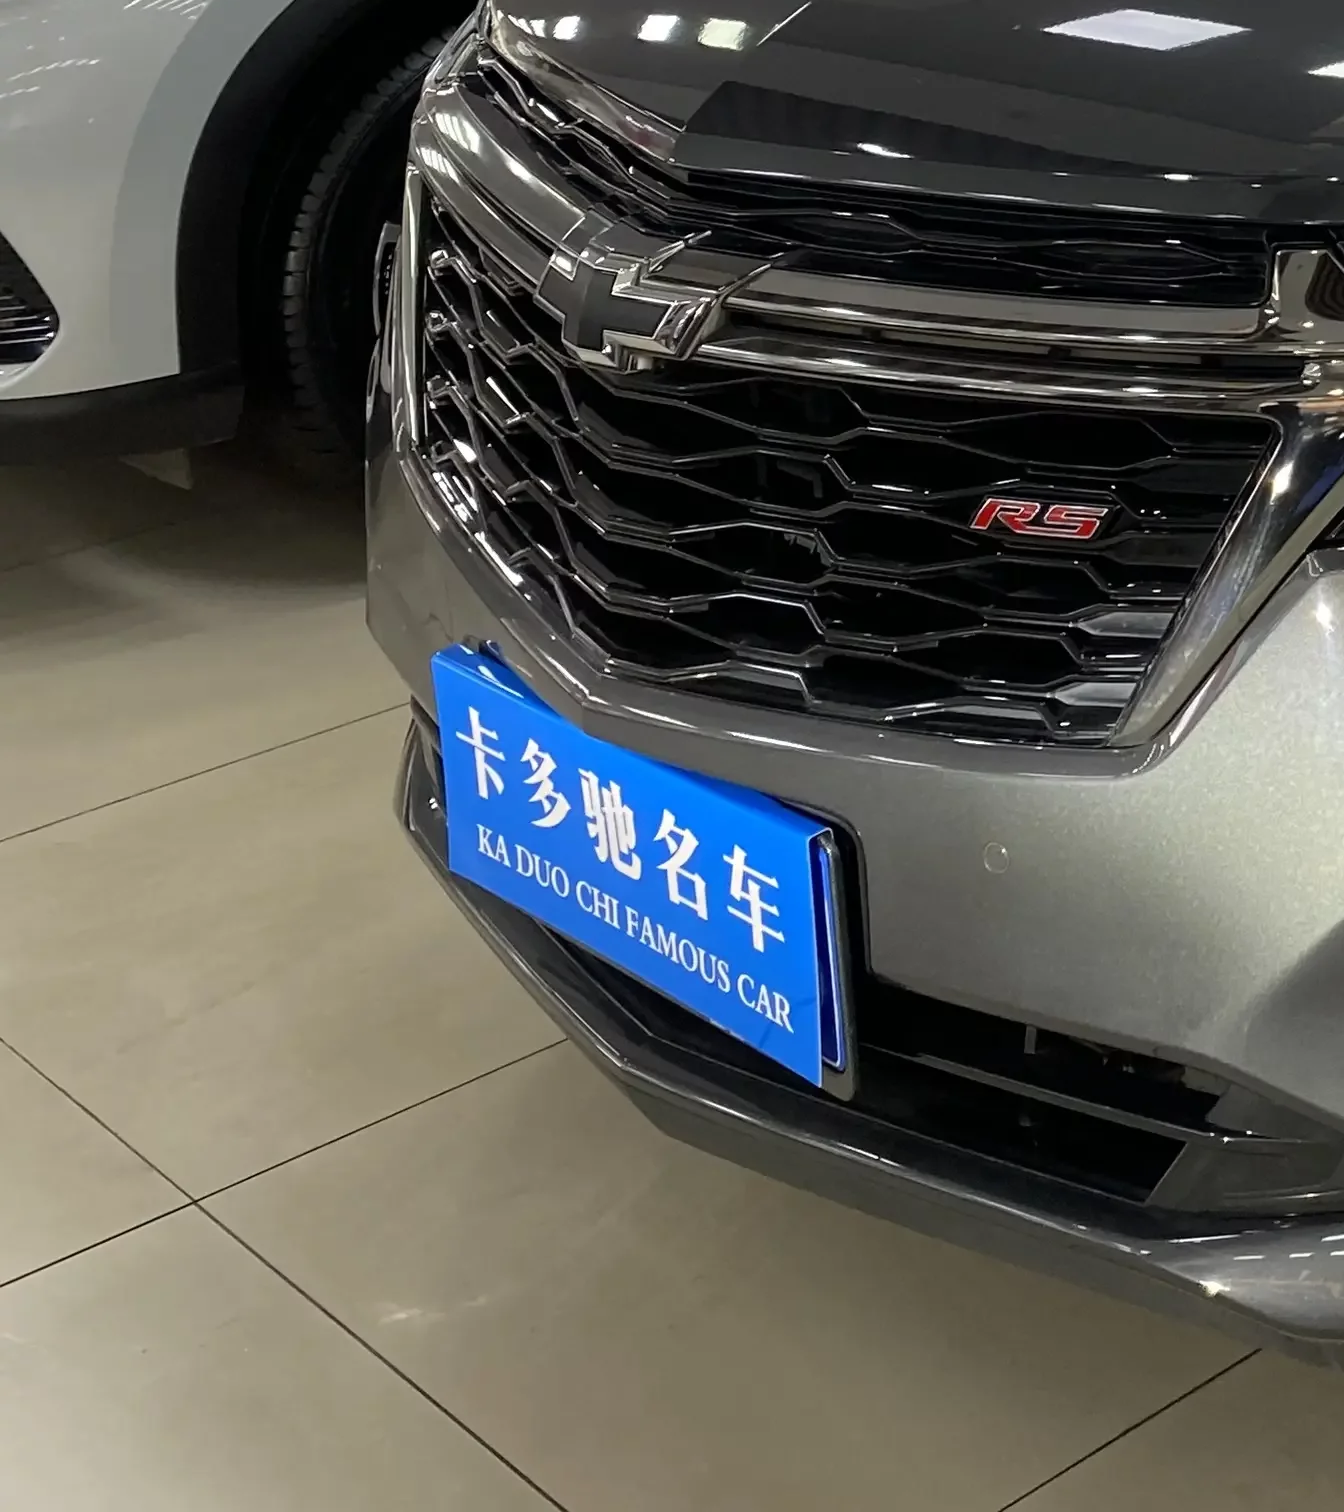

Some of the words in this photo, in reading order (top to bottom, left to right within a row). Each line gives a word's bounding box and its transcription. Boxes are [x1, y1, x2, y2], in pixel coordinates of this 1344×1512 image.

[969, 497, 1109, 541] RS
[455, 705, 786, 953] 卡多驰名车
[476, 823, 512, 875] KA
[516, 844, 571, 900] DUO
[575, 878, 622, 931] CHI
[624, 910, 732, 994] FAMOUS
[736, 974, 795, 1035] CAR
